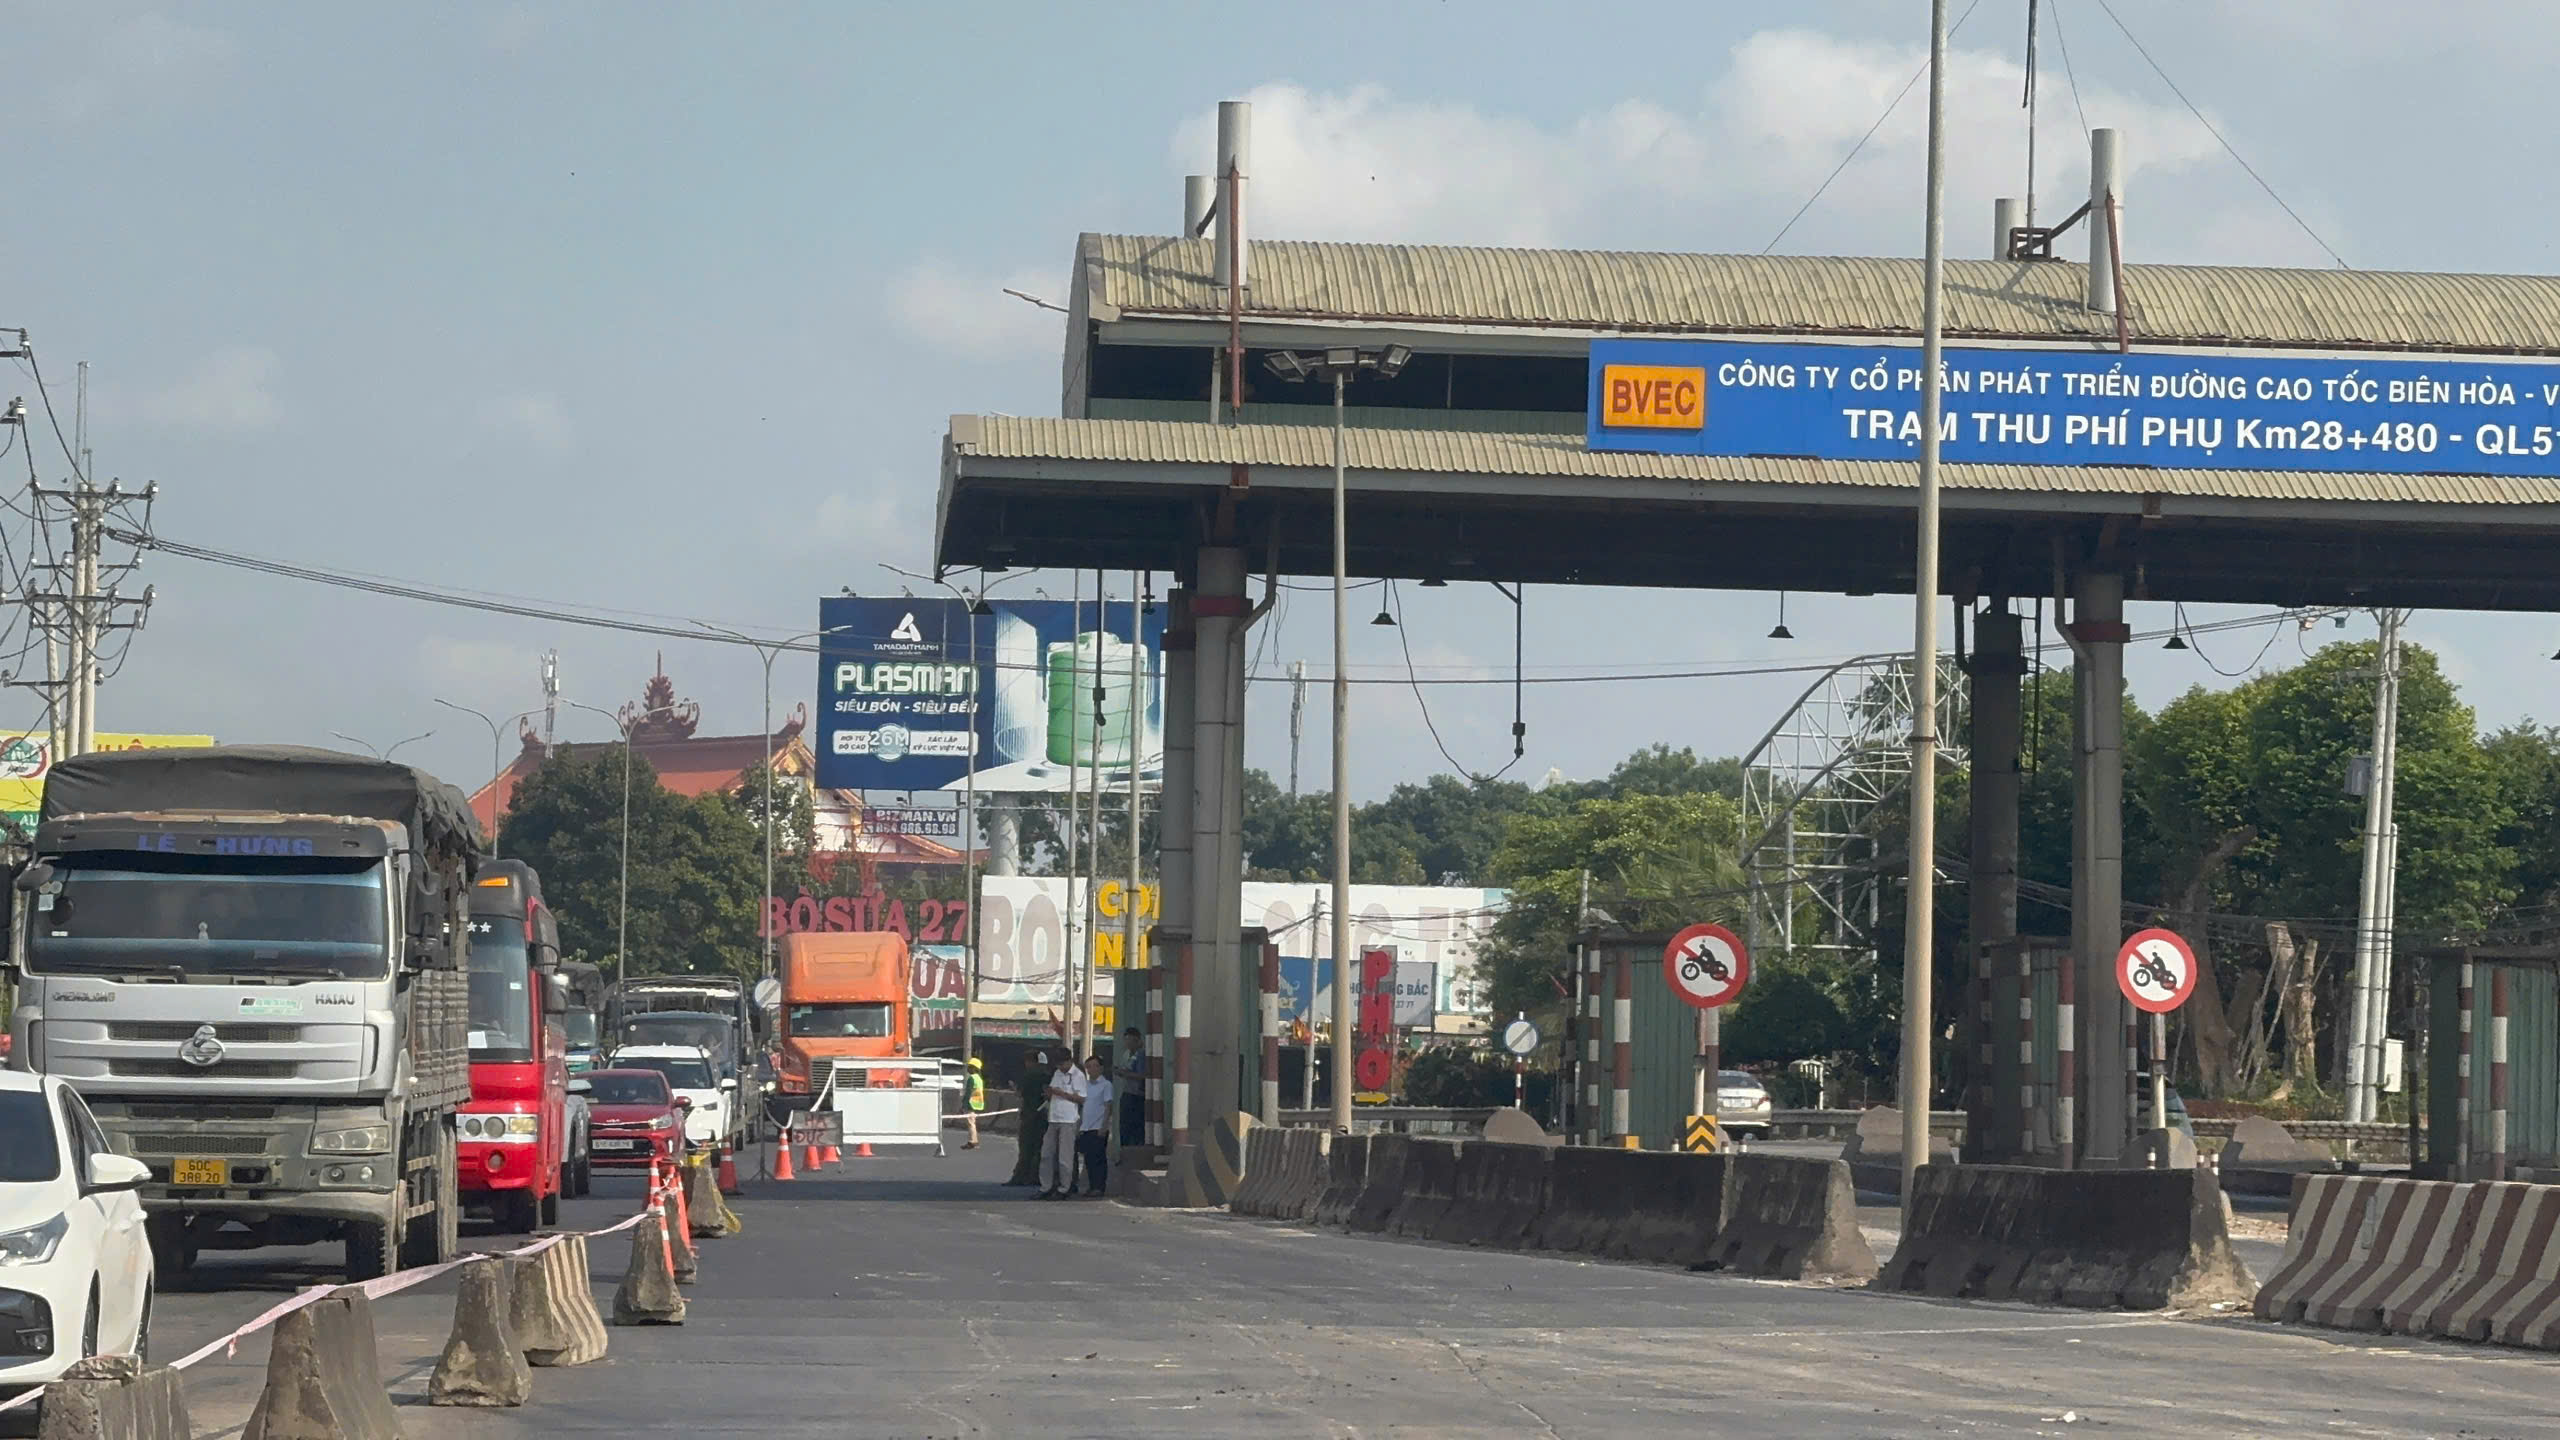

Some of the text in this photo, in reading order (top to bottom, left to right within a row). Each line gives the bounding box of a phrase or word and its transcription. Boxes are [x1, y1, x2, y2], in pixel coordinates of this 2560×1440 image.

[1611, 379, 1697, 416] BVEC
[1718, 358, 1795, 388] CÔNG
[1805, 366, 1840, 390] TY
[1850, 356, 1887, 391] CỔ
[1897, 361, 1971, 393] PHẦN
[1979, 366, 2051, 395] PHÁT
[2062, 362, 2141, 397] TRIỂN
[2150, 368, 2246, 400] ĐƯỜNG
[2256, 377, 2313, 402] CAO
[2322, 369, 2378, 403] TỐC
[2388, 373, 2450, 404] BIÊN
[2459, 375, 2516, 405] HÒA
[2542, 384, 2560, 407] V
[1842, 409, 1957, 447] TRẠM
[1971, 411, 2051, 444] THU
[2064, 407, 2131, 447] PHÍ
[2142, 416, 2223, 456] PHỤ
[2236, 418, 2438, 453] Km28+480
[835, 663, 978, 693] PLASMAN
[834, 698, 866, 712] SIÊU
[876, 810, 957, 822] BIZMAN.VN
[757, 886, 819, 937] BÒ
[919, 899, 968, 942] 27
[978, 879, 1063, 998] BÒ
[188, 1159, 211, 1171] 60C
